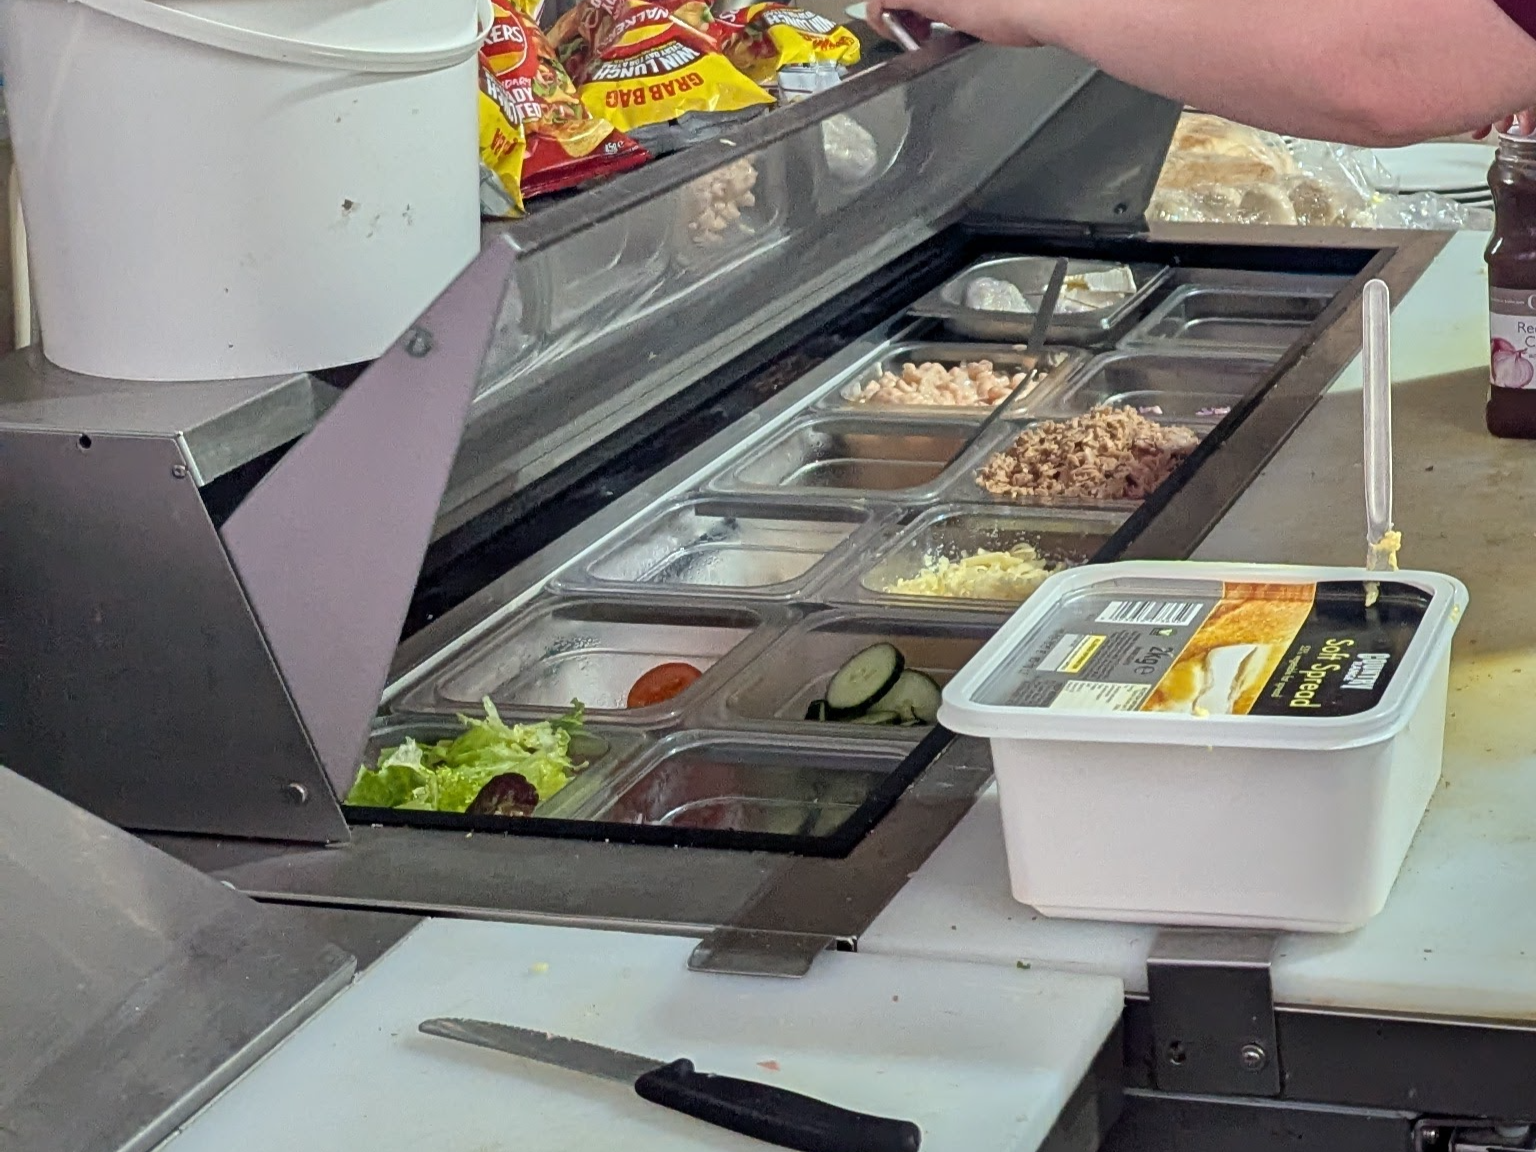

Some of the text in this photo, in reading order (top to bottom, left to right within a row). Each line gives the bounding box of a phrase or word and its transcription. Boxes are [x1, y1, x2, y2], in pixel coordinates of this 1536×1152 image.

[592, 46, 701, 81] WIN LUNCH
[606, 72, 705, 108] GRAB BAG
[1289, 638, 1355, 708] Soft Spread
